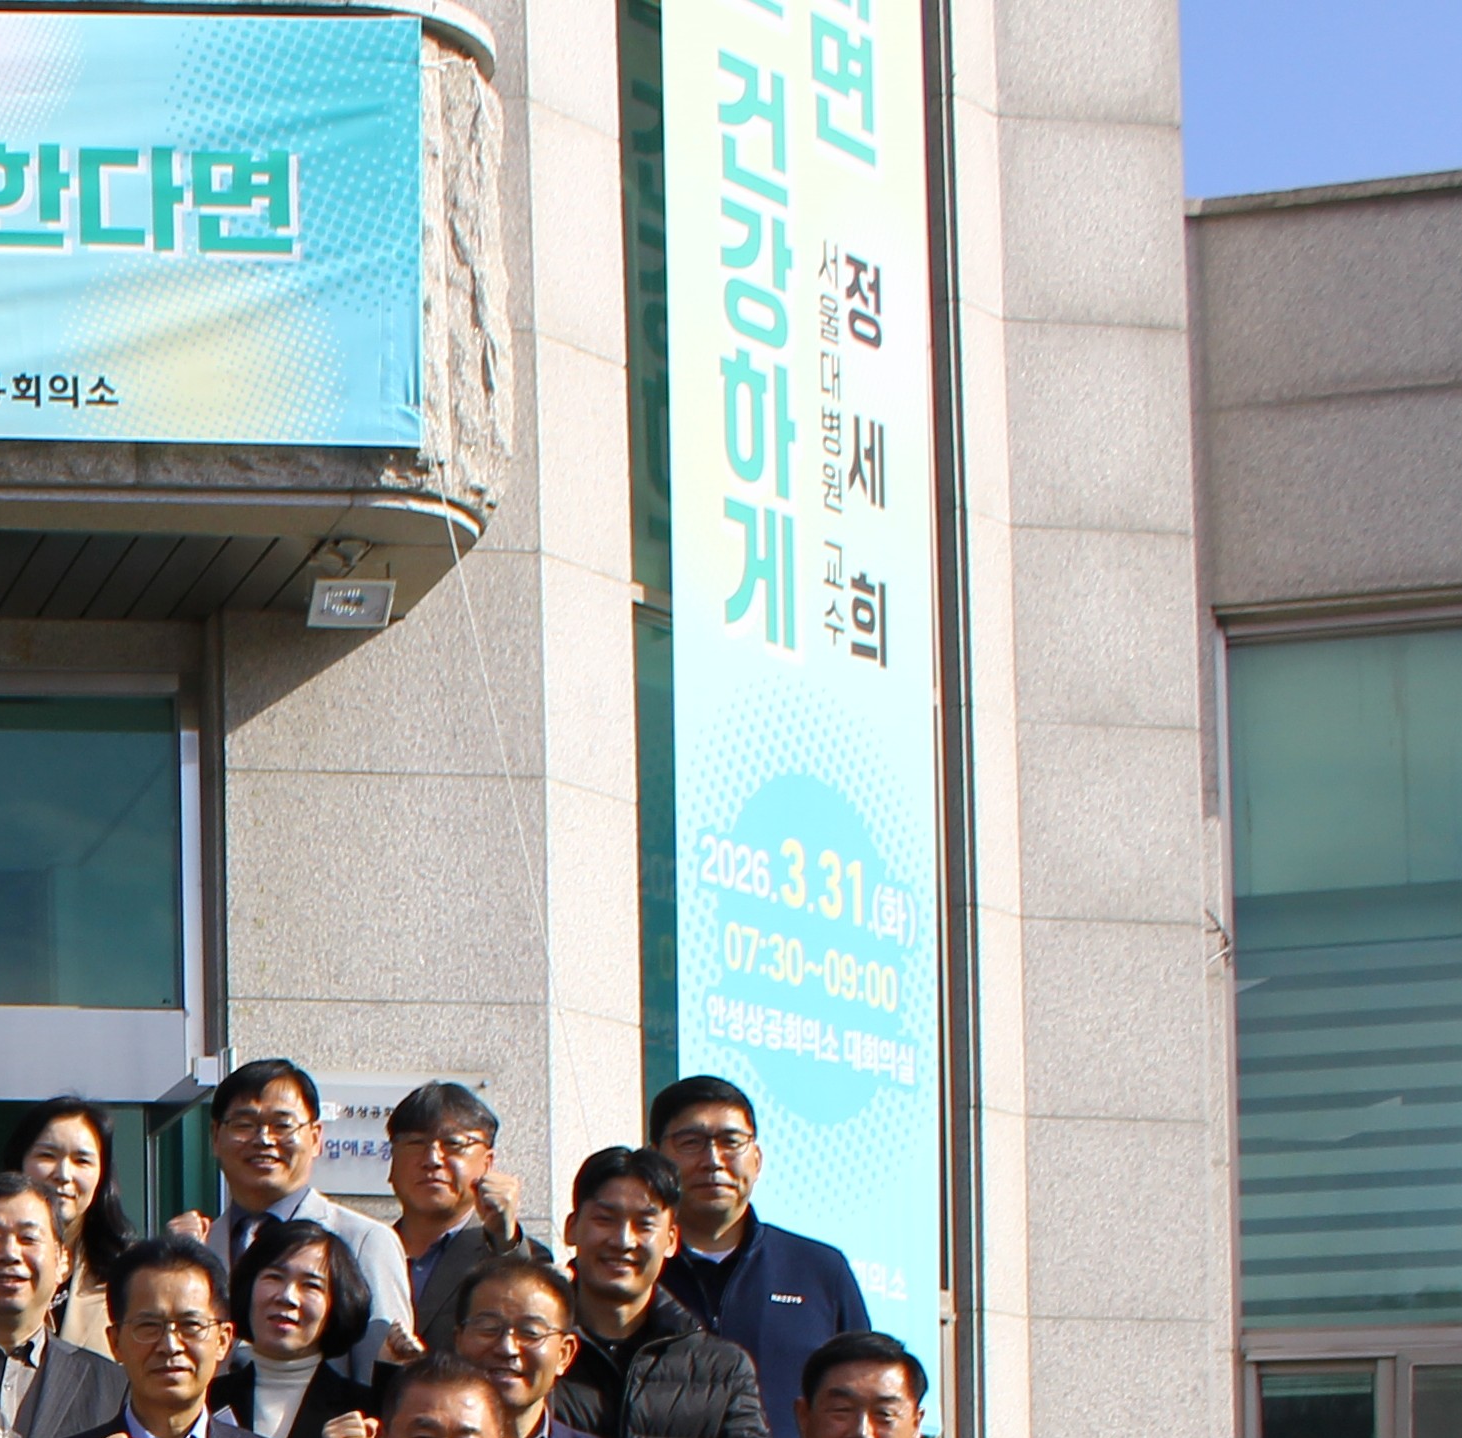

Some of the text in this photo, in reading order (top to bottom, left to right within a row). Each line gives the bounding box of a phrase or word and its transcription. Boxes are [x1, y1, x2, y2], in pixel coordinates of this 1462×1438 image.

[718, 48, 796, 652] 건강하게
[824, 540, 845, 646] 교수
[724, 921, 899, 1014] 07:30~09:00
[706, 994, 917, 1087] 안성상공회의소 대회의실
